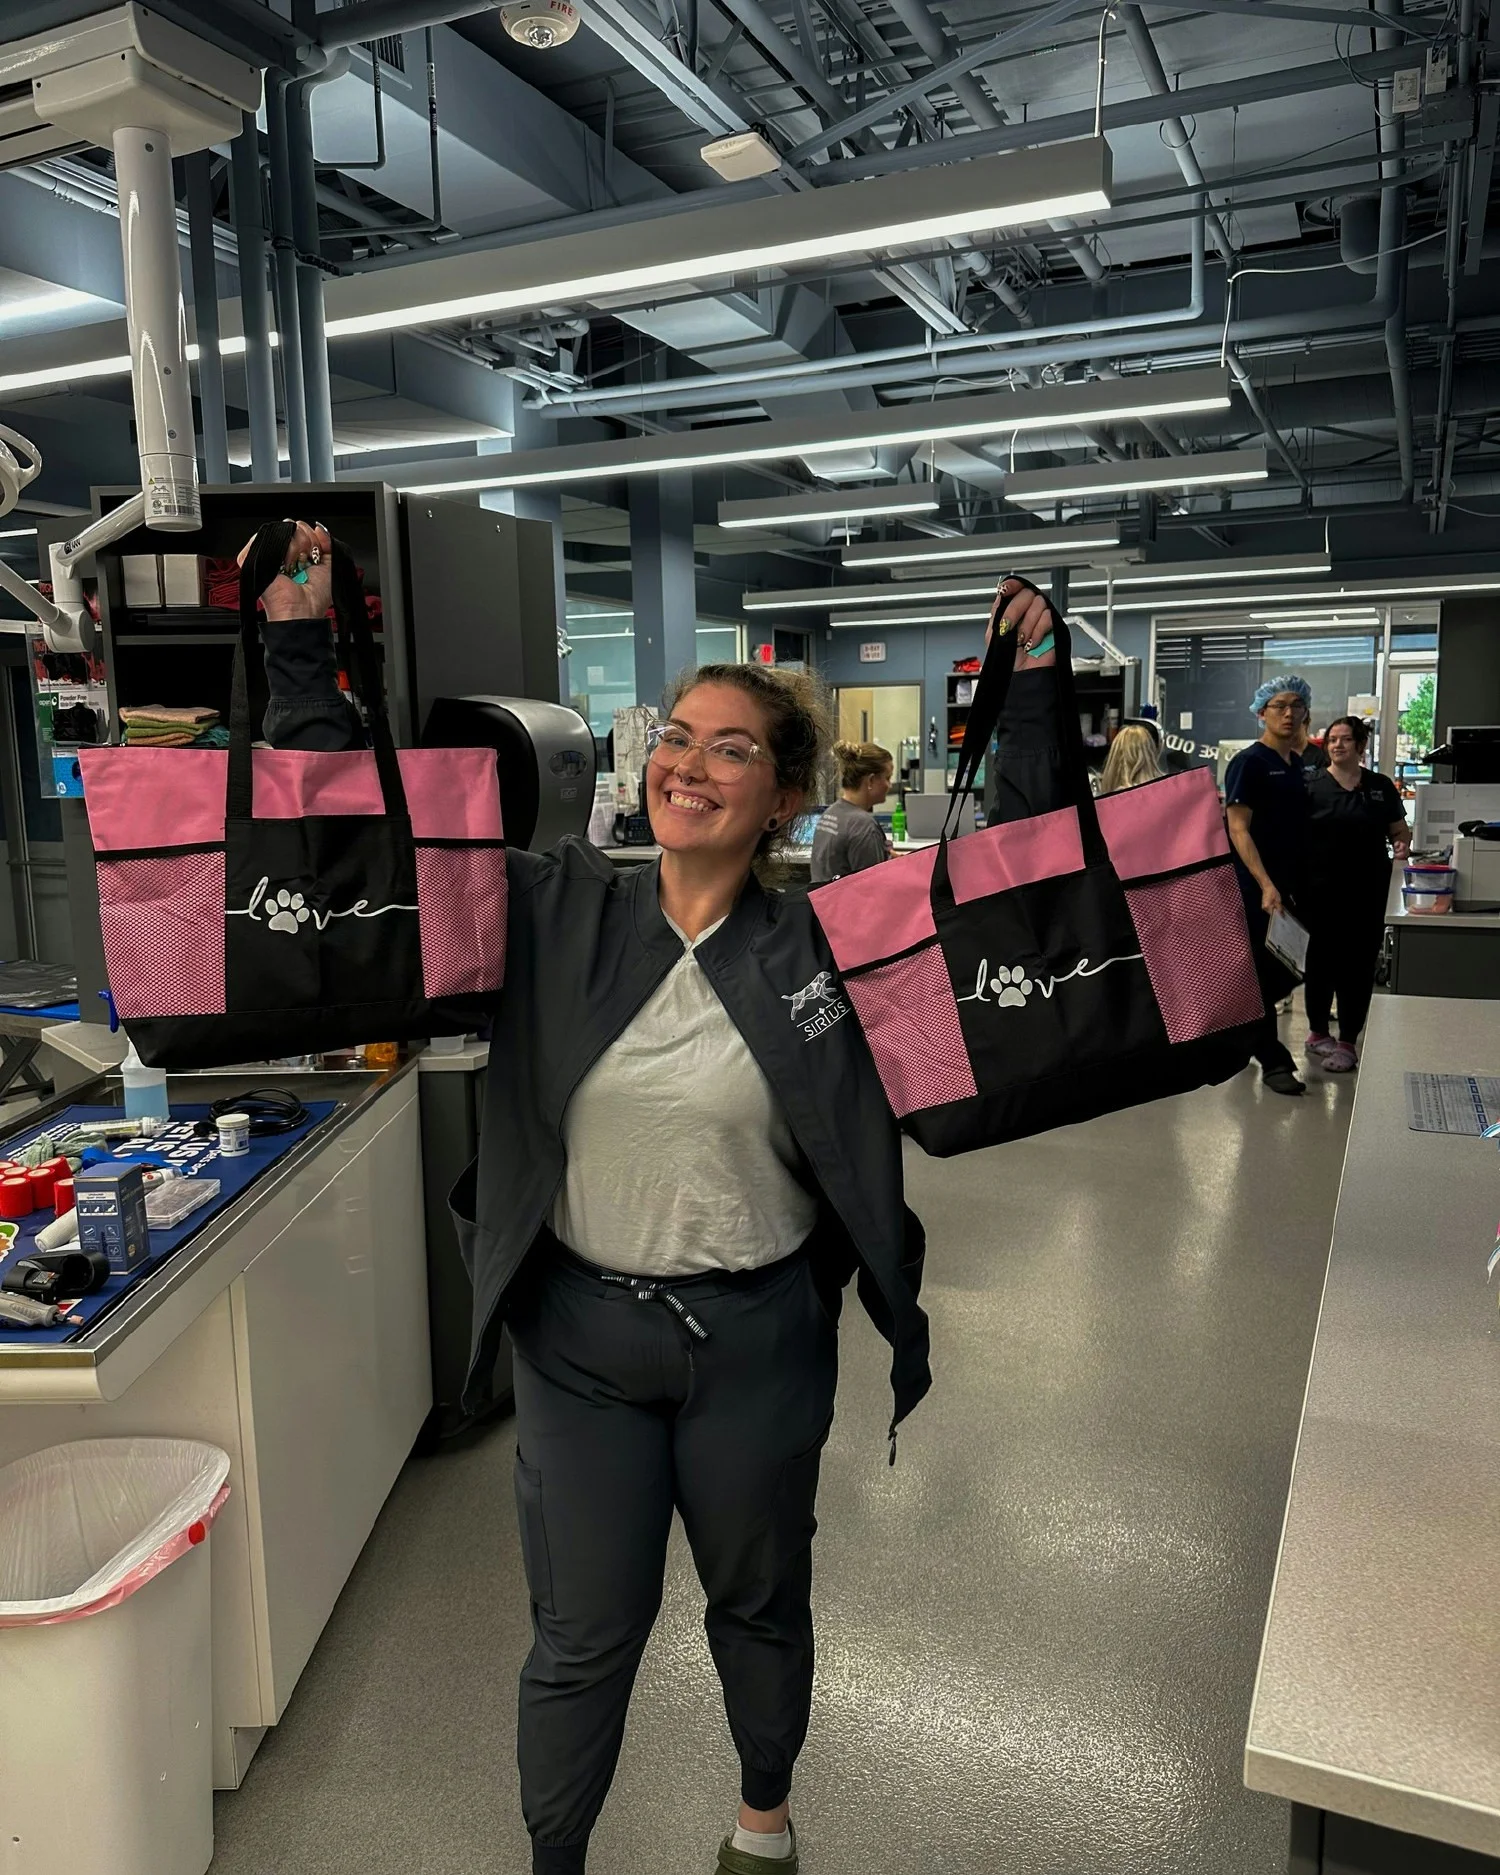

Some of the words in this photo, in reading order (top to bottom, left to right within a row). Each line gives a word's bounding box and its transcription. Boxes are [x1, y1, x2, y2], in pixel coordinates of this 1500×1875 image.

[550, 0, 574, 17] FIRE
[804, 1001, 847, 1037] SIRIUS
[145, 1140, 182, 1152] IS
[168, 1141, 211, 1158] US
